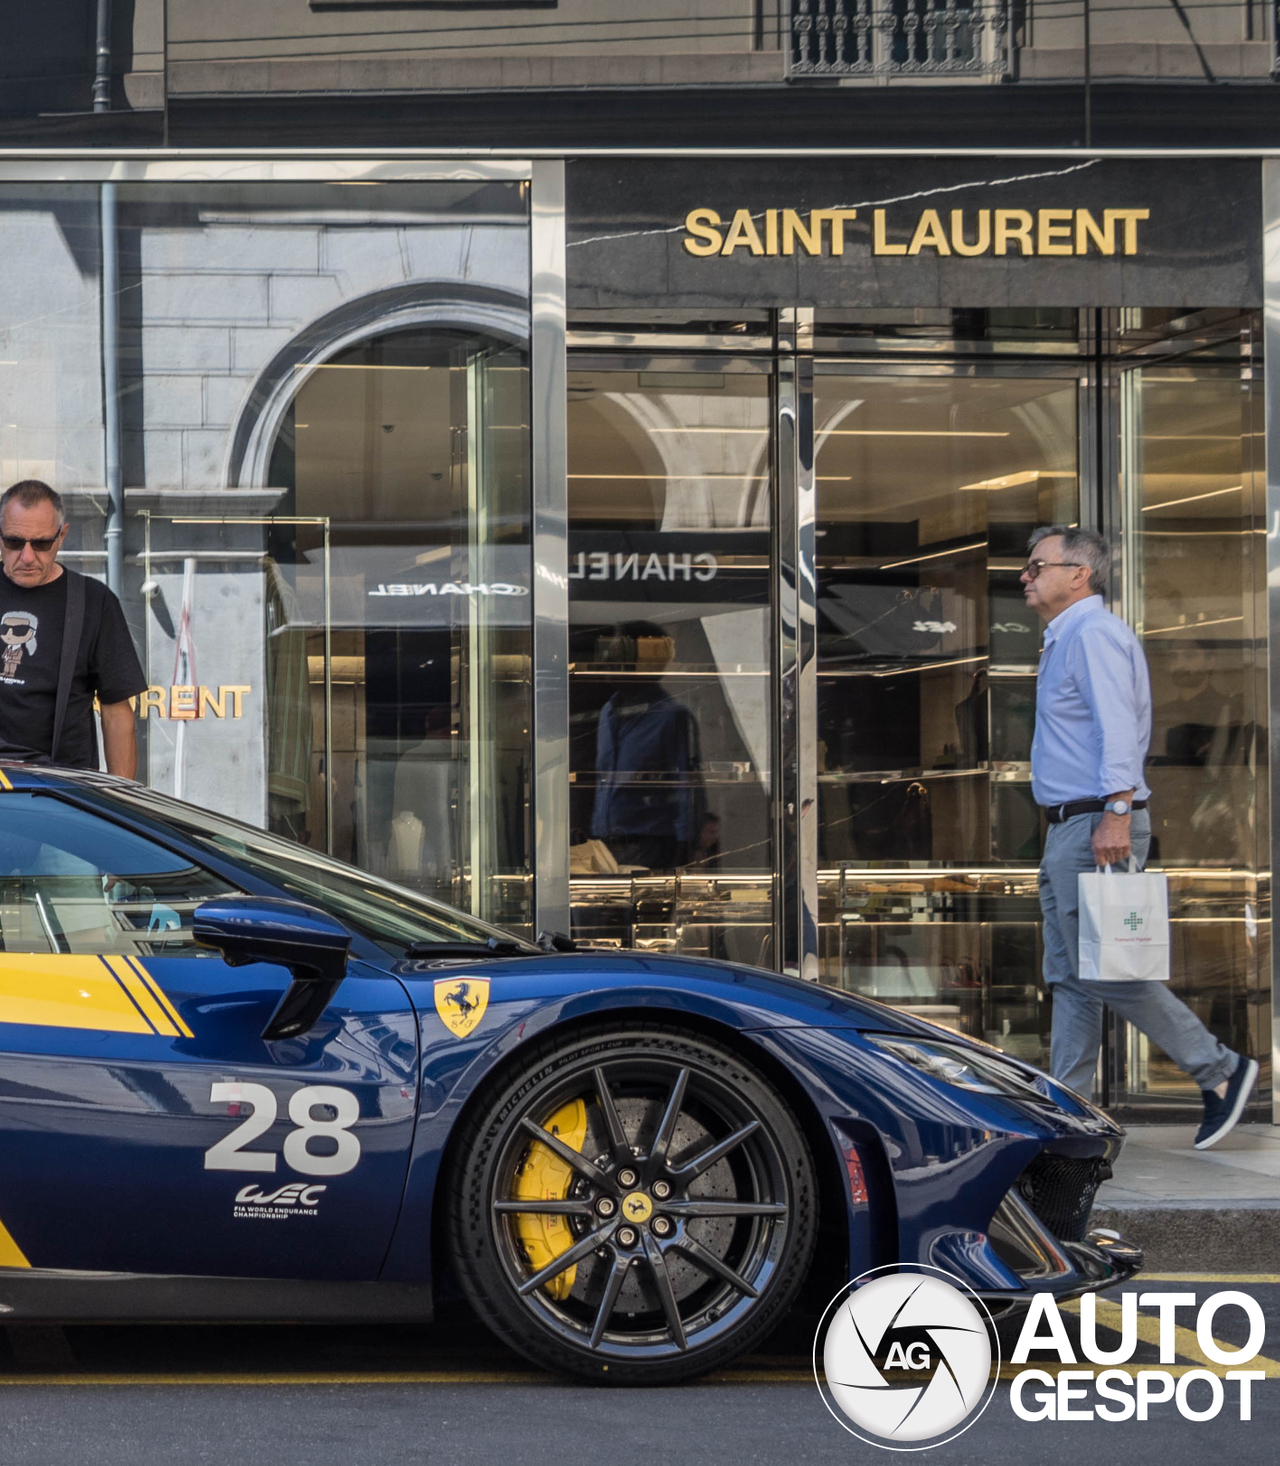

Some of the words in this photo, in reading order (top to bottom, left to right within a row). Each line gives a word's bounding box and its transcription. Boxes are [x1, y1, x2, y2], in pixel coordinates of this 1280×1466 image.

[683, 208, 856, 256] SAINT
[873, 208, 1150, 256] LAURENT
[93, 684, 252, 720] RENT
[496, 1064, 555, 1121] MICHELIN
[556, 1051, 579, 1066] PILOT
[578, 1043, 605, 1056] SPORT
[204, 1082, 361, 1175] 28
[235, 1183, 327, 1206] WEC
[274, 1207, 318, 1216] ENDURANCE
[233, 1211, 288, 1219] CHAMPIONSHIP
